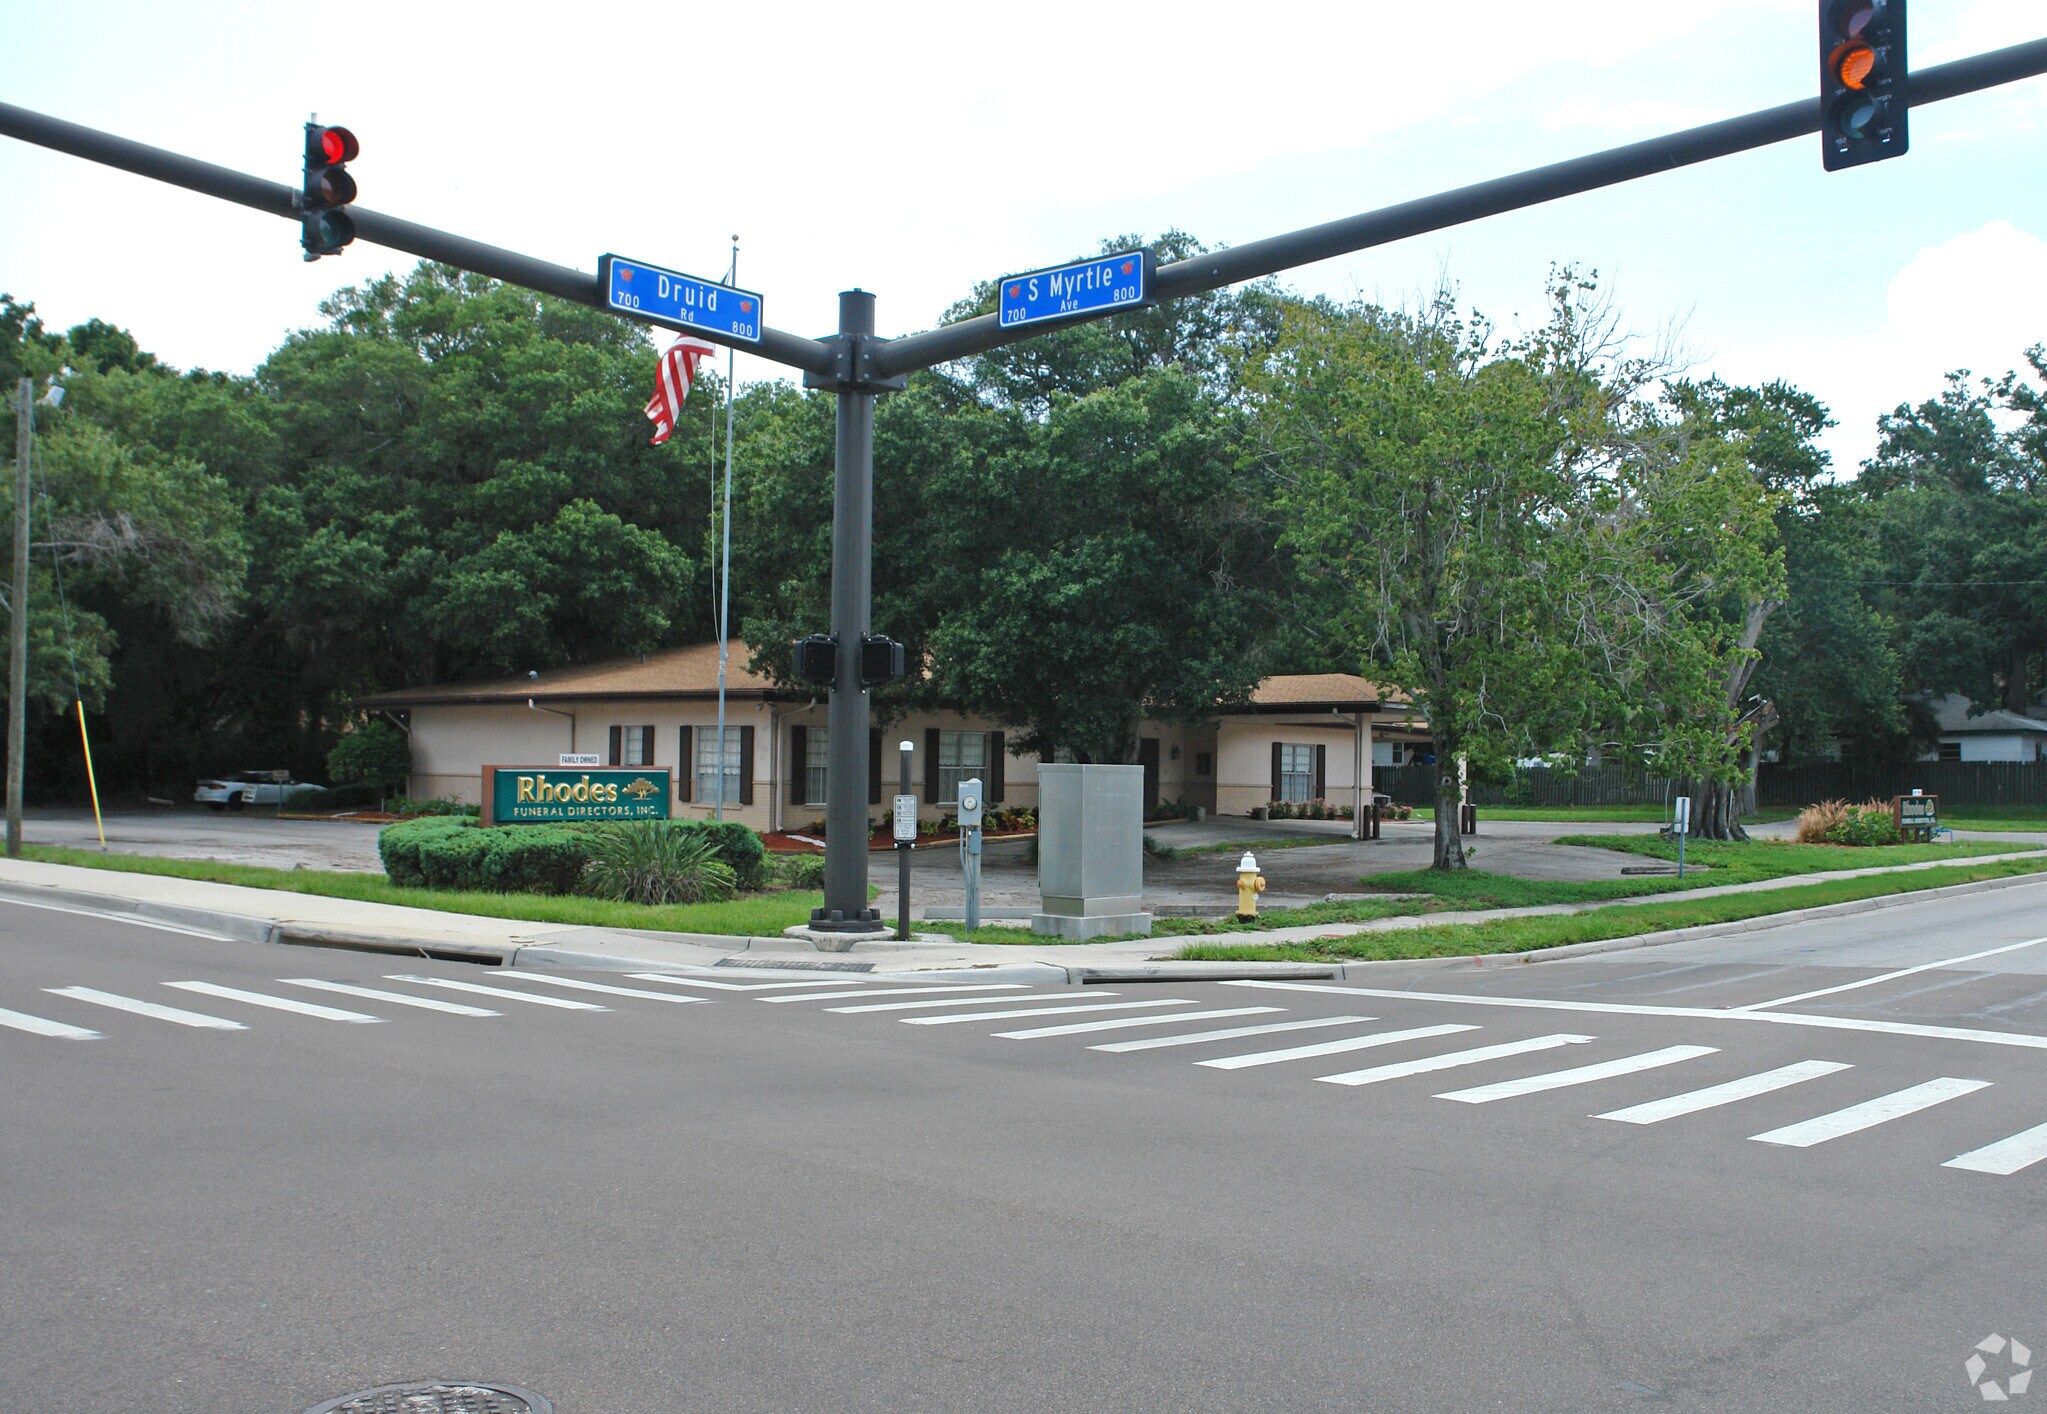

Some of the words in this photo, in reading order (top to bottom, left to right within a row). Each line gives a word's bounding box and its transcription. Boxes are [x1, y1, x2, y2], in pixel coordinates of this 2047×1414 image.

[1028, 278, 1039, 302] S
[1050, 265, 1112, 300] Myrtle
[618, 292, 640, 308] 700
[658, 274, 718, 312] Druid
[1113, 286, 1135, 301] 800
[1060, 299, 1078, 312] Ave
[680, 308, 694, 322] Rd
[1007, 307, 1026, 322] 700
[732, 321, 753, 336] 800
[561, 756, 579, 764] FAMILY
[580, 756, 598, 764] OWNED
[517, 774, 618, 804] Rhodes
[513, 807, 564, 816] FUNERAL
[567, 805, 633, 816] DIRECTORS,
[636, 805, 659, 815] INC.
